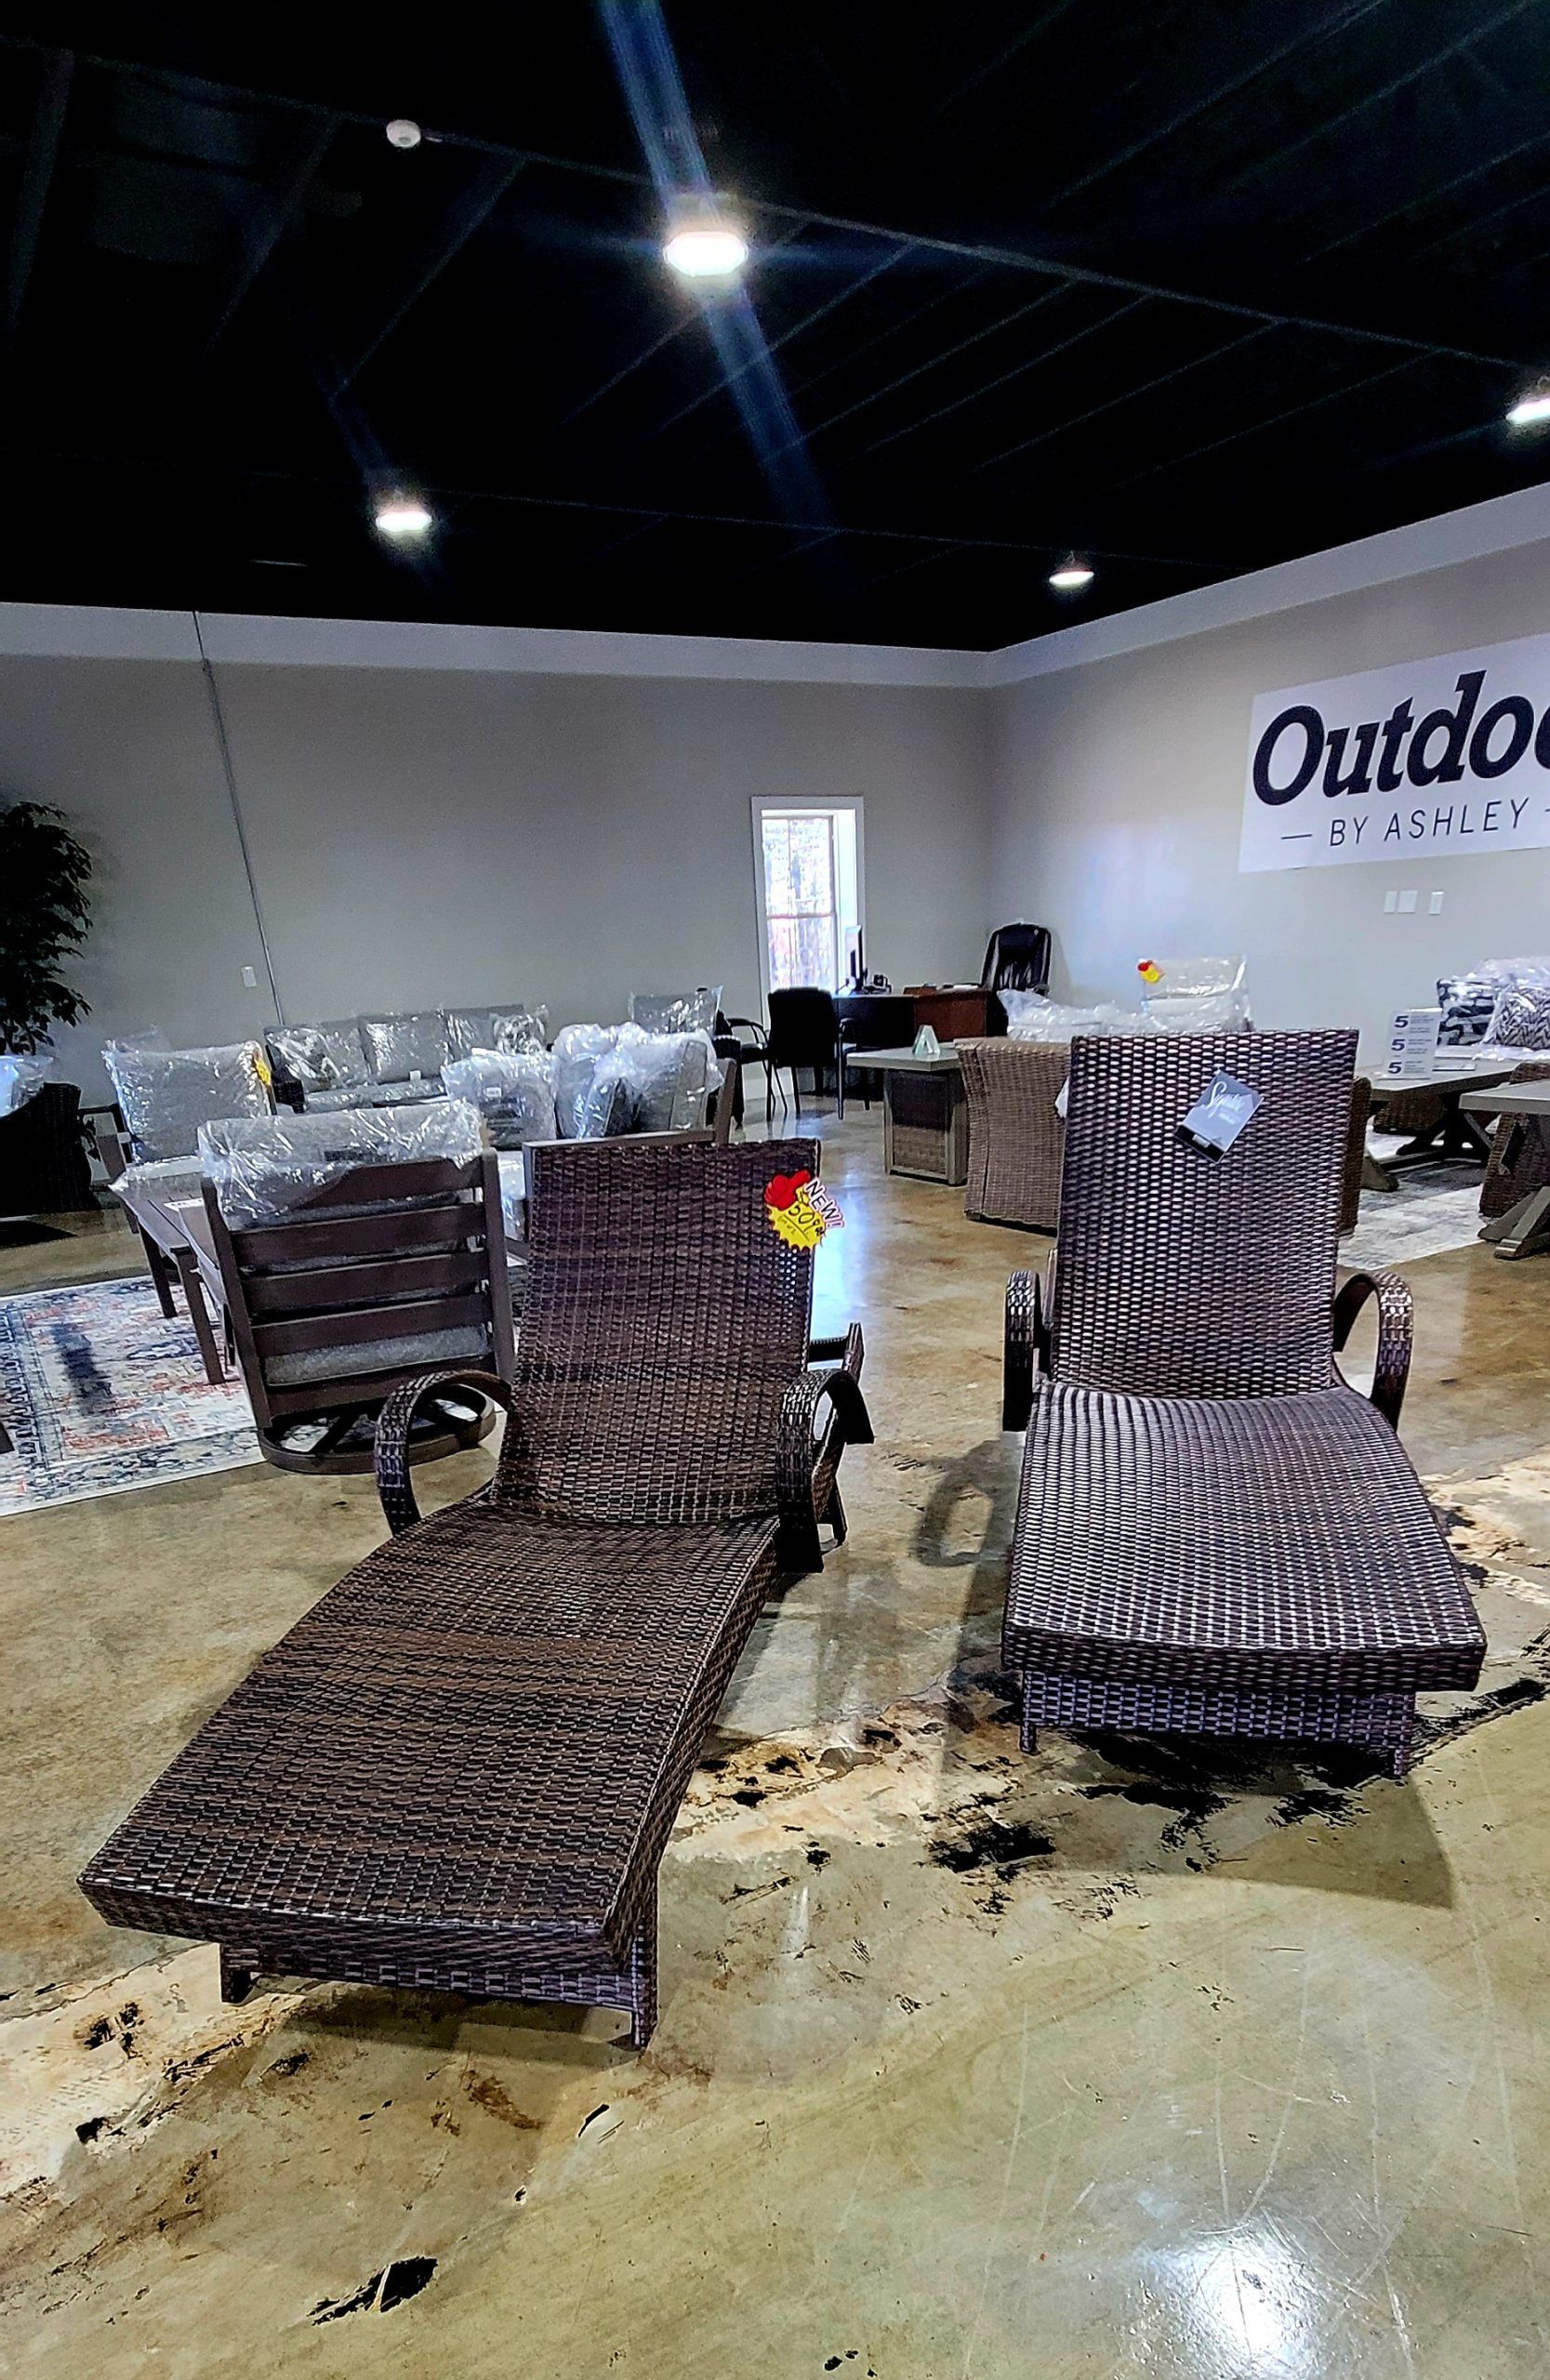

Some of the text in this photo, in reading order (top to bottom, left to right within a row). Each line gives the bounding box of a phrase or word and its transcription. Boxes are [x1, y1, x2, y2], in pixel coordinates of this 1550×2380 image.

[1252, 669, 1550, 806] Outdo
[1330, 797, 1530, 847] BY ASHLEY
[1395, 1015, 1409, 1028] 5
[1391, 1038, 1405, 1051] 5
[1387, 1061, 1402, 1074] 5
[805, 1180, 842, 1228] NEW!
